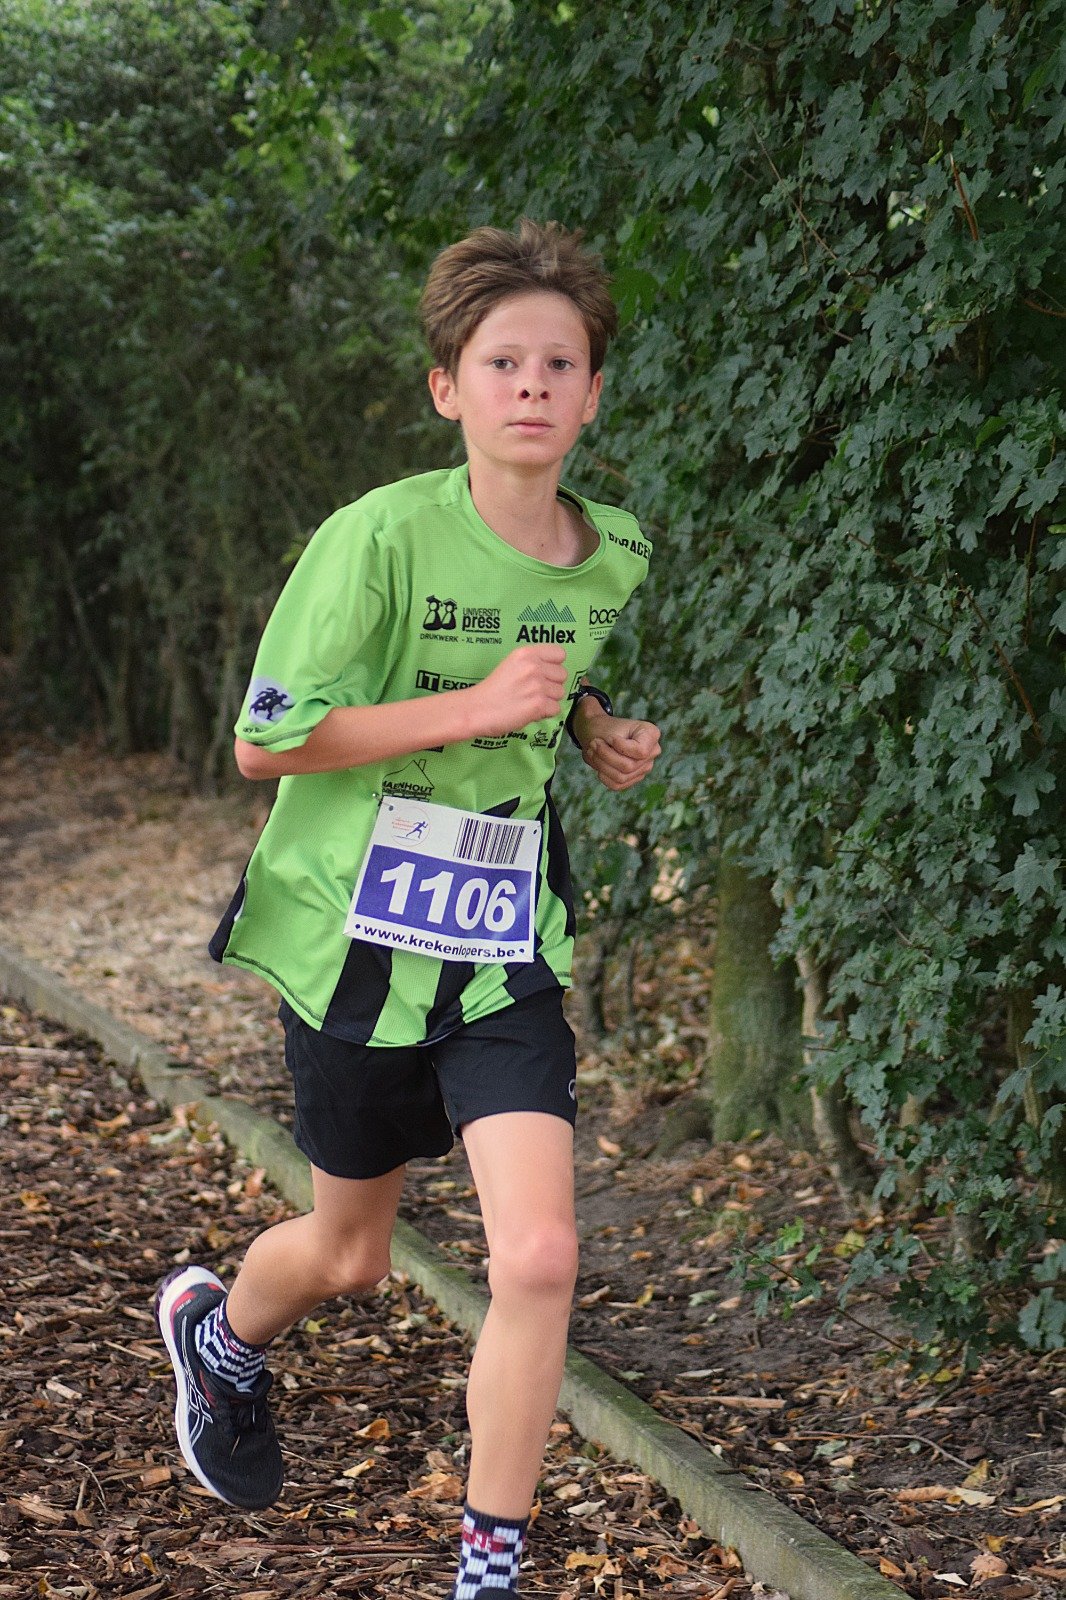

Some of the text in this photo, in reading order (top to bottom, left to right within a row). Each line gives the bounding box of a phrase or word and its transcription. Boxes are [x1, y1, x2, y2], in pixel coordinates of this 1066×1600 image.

[462, 607, 501, 617] UNIVERSITY
[462, 615, 501, 631] press
[420, 633, 459, 643] DRUKWERK
[466, 636, 474, 644] XL
[475, 637, 503, 645] PRINTING
[516, 624, 576, 643] Athlex
[418, 671, 439, 690] IT
[380, 861, 517, 933] 1106
[364, 925, 516, 958] www.krekenlopers.be
